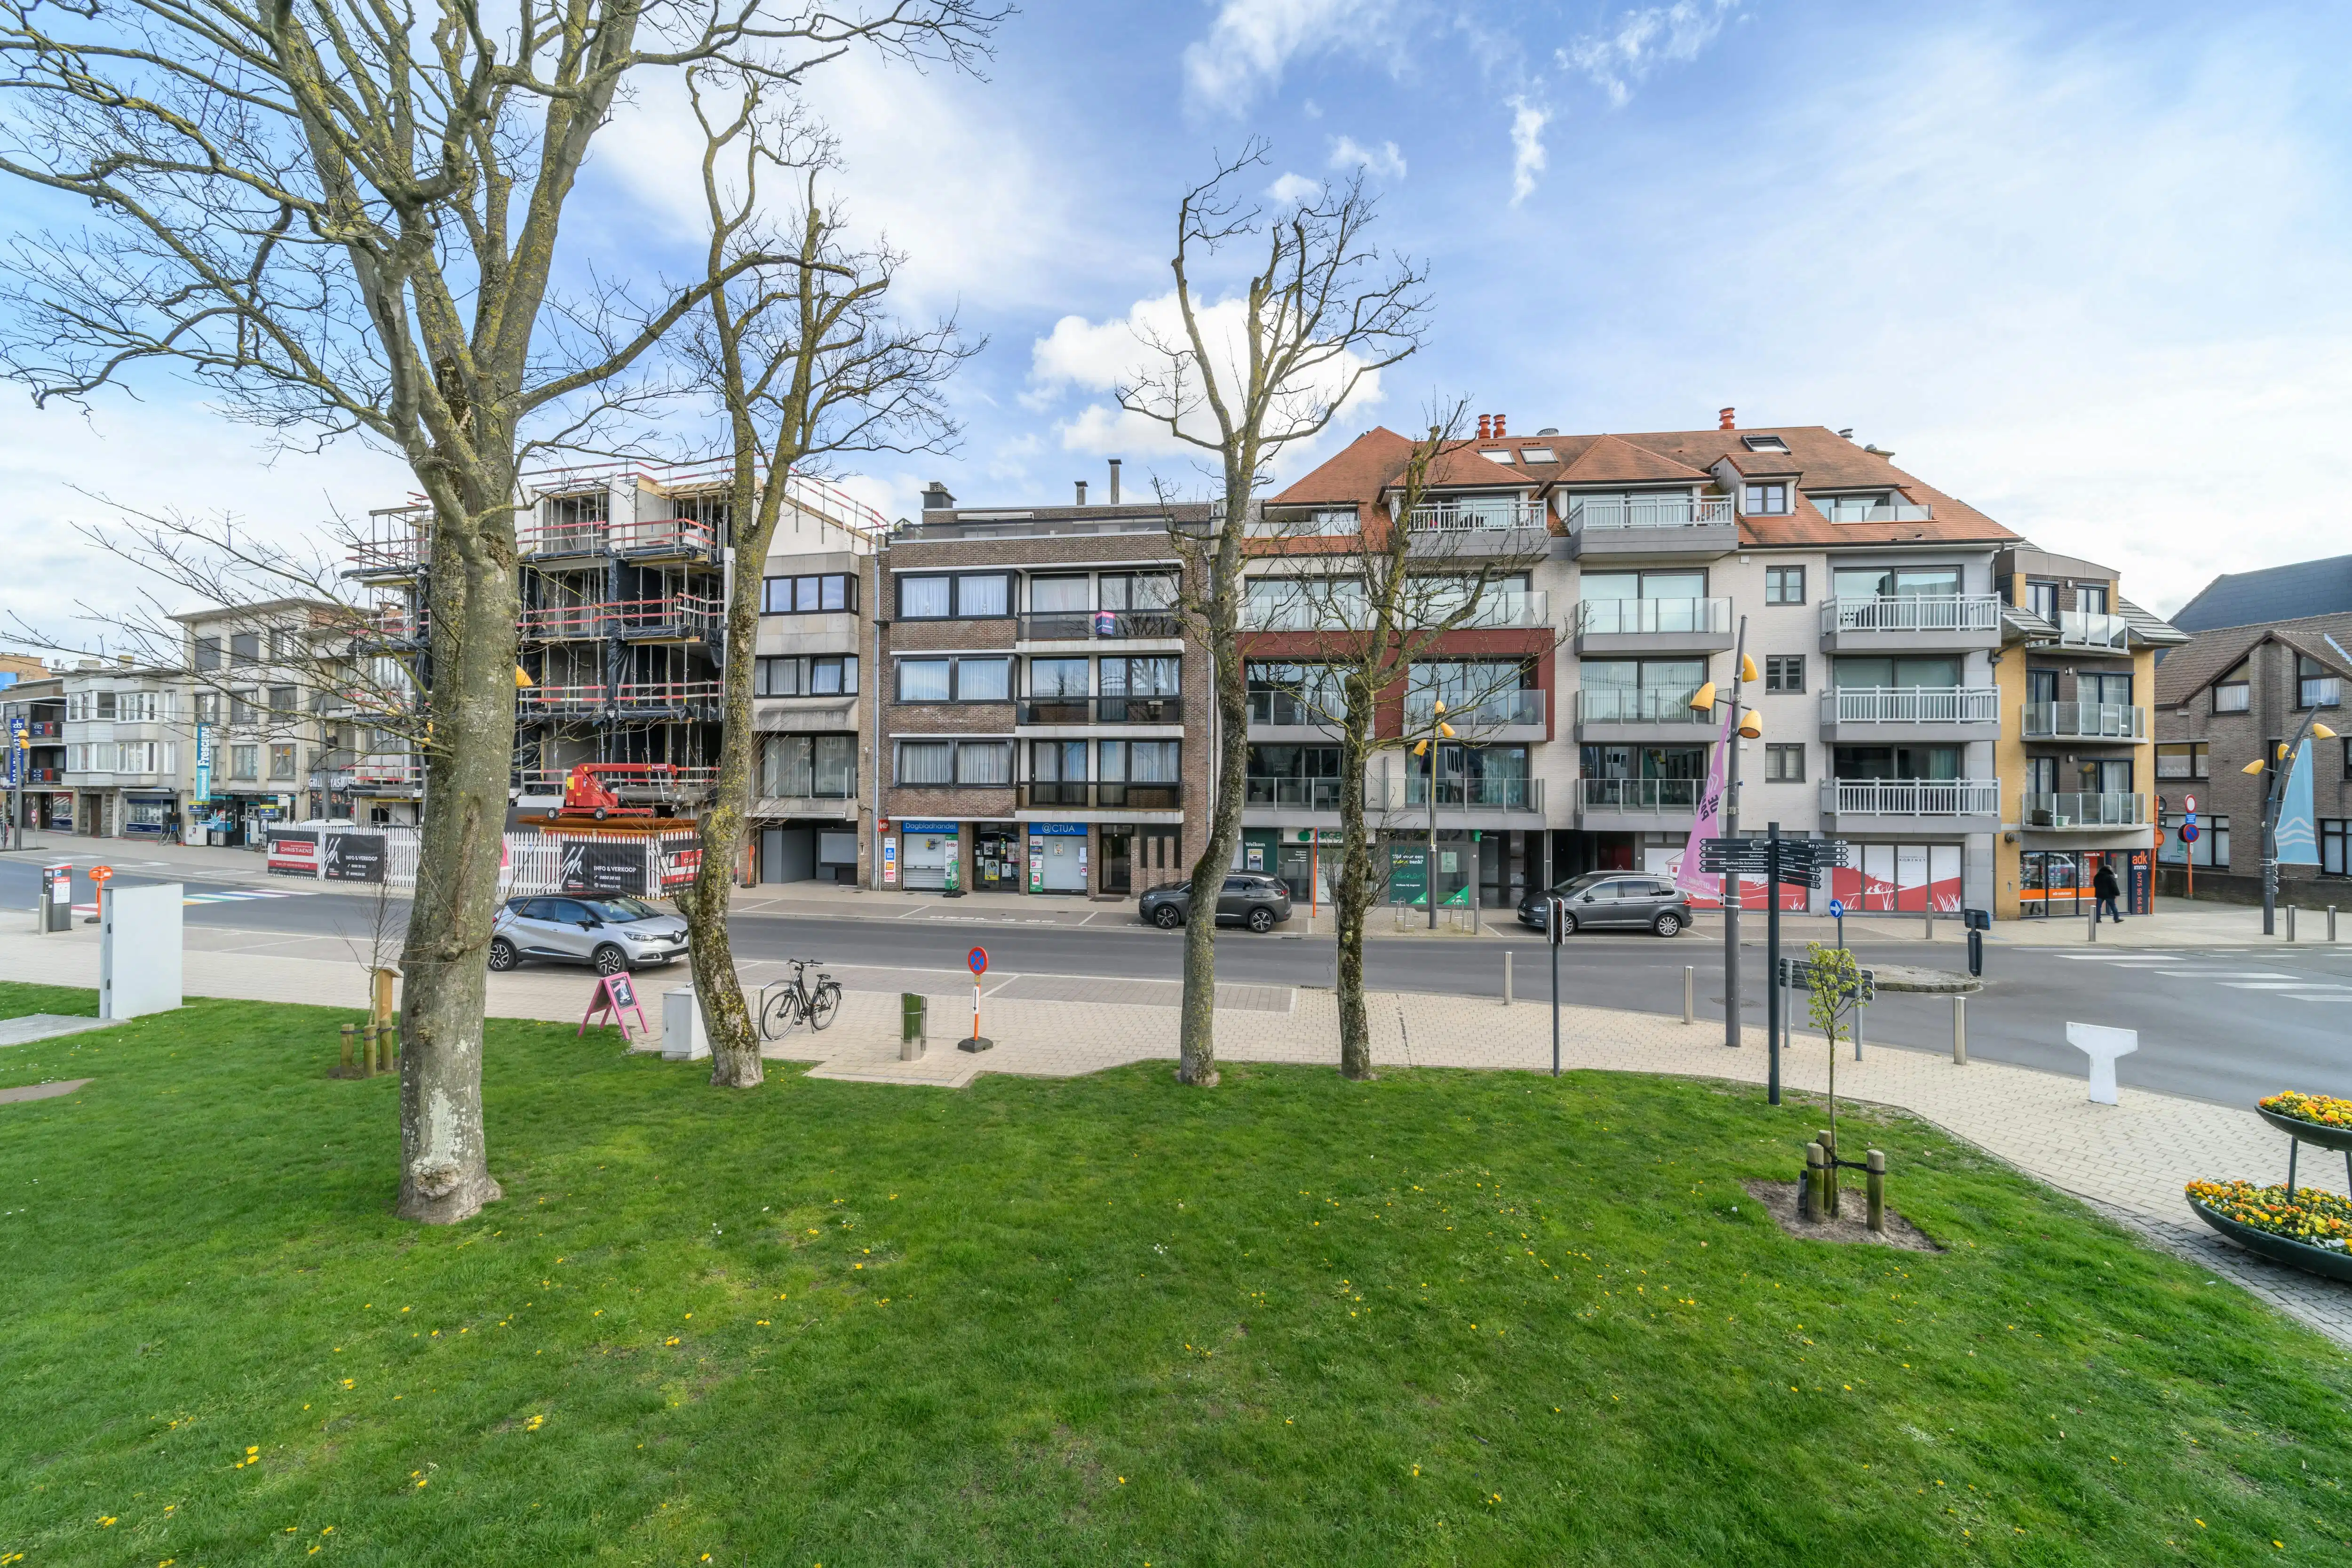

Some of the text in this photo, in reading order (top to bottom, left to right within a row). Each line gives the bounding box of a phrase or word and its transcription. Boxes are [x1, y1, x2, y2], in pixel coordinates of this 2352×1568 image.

[199, 770, 207, 800] Supermarkt
[330, 777, 355, 788] YASMINE
[1042, 823, 1075, 833] @CTUA
[2132, 850, 2148, 865] adk
